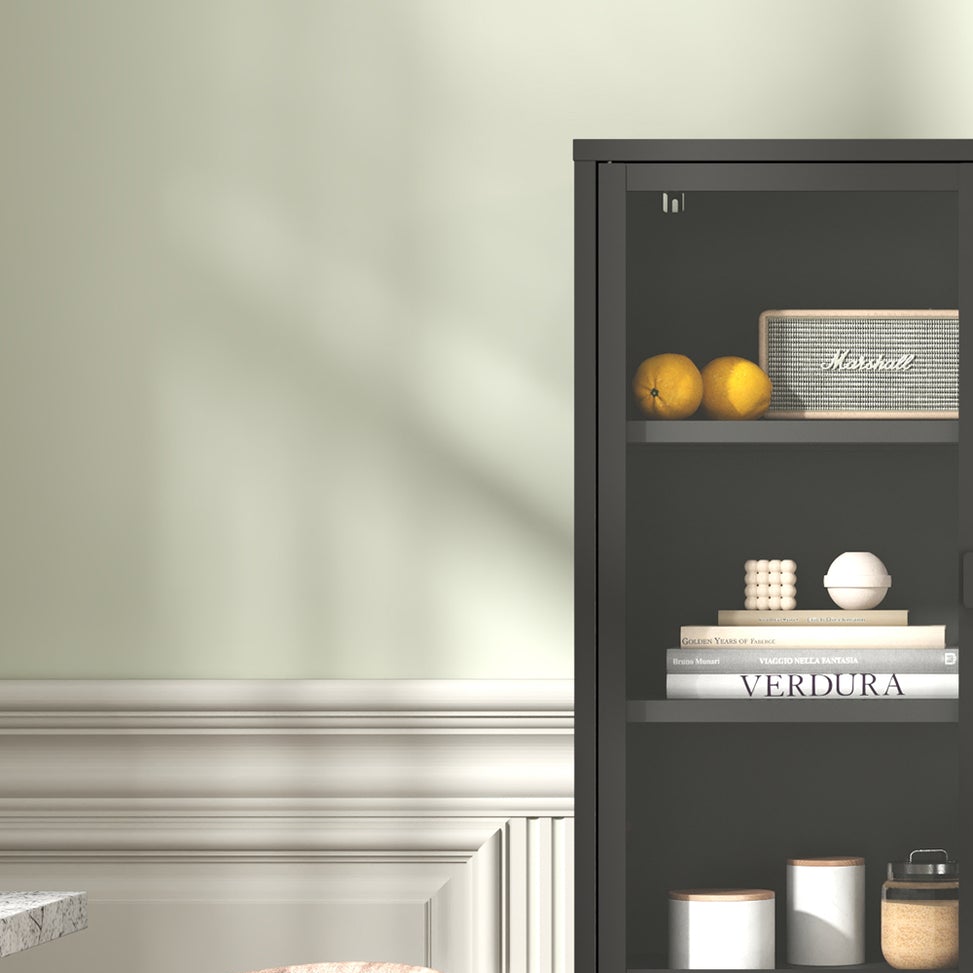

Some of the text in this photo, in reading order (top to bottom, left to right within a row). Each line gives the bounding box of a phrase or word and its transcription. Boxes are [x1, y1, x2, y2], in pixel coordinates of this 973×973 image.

[820, 348, 917, 371] Marshall
[759, 657, 794, 665] VIAGGIO
[794, 657, 821, 665] NELLA
[820, 657, 860, 665] FANTASIA
[740, 672, 905, 697] VERDURA
